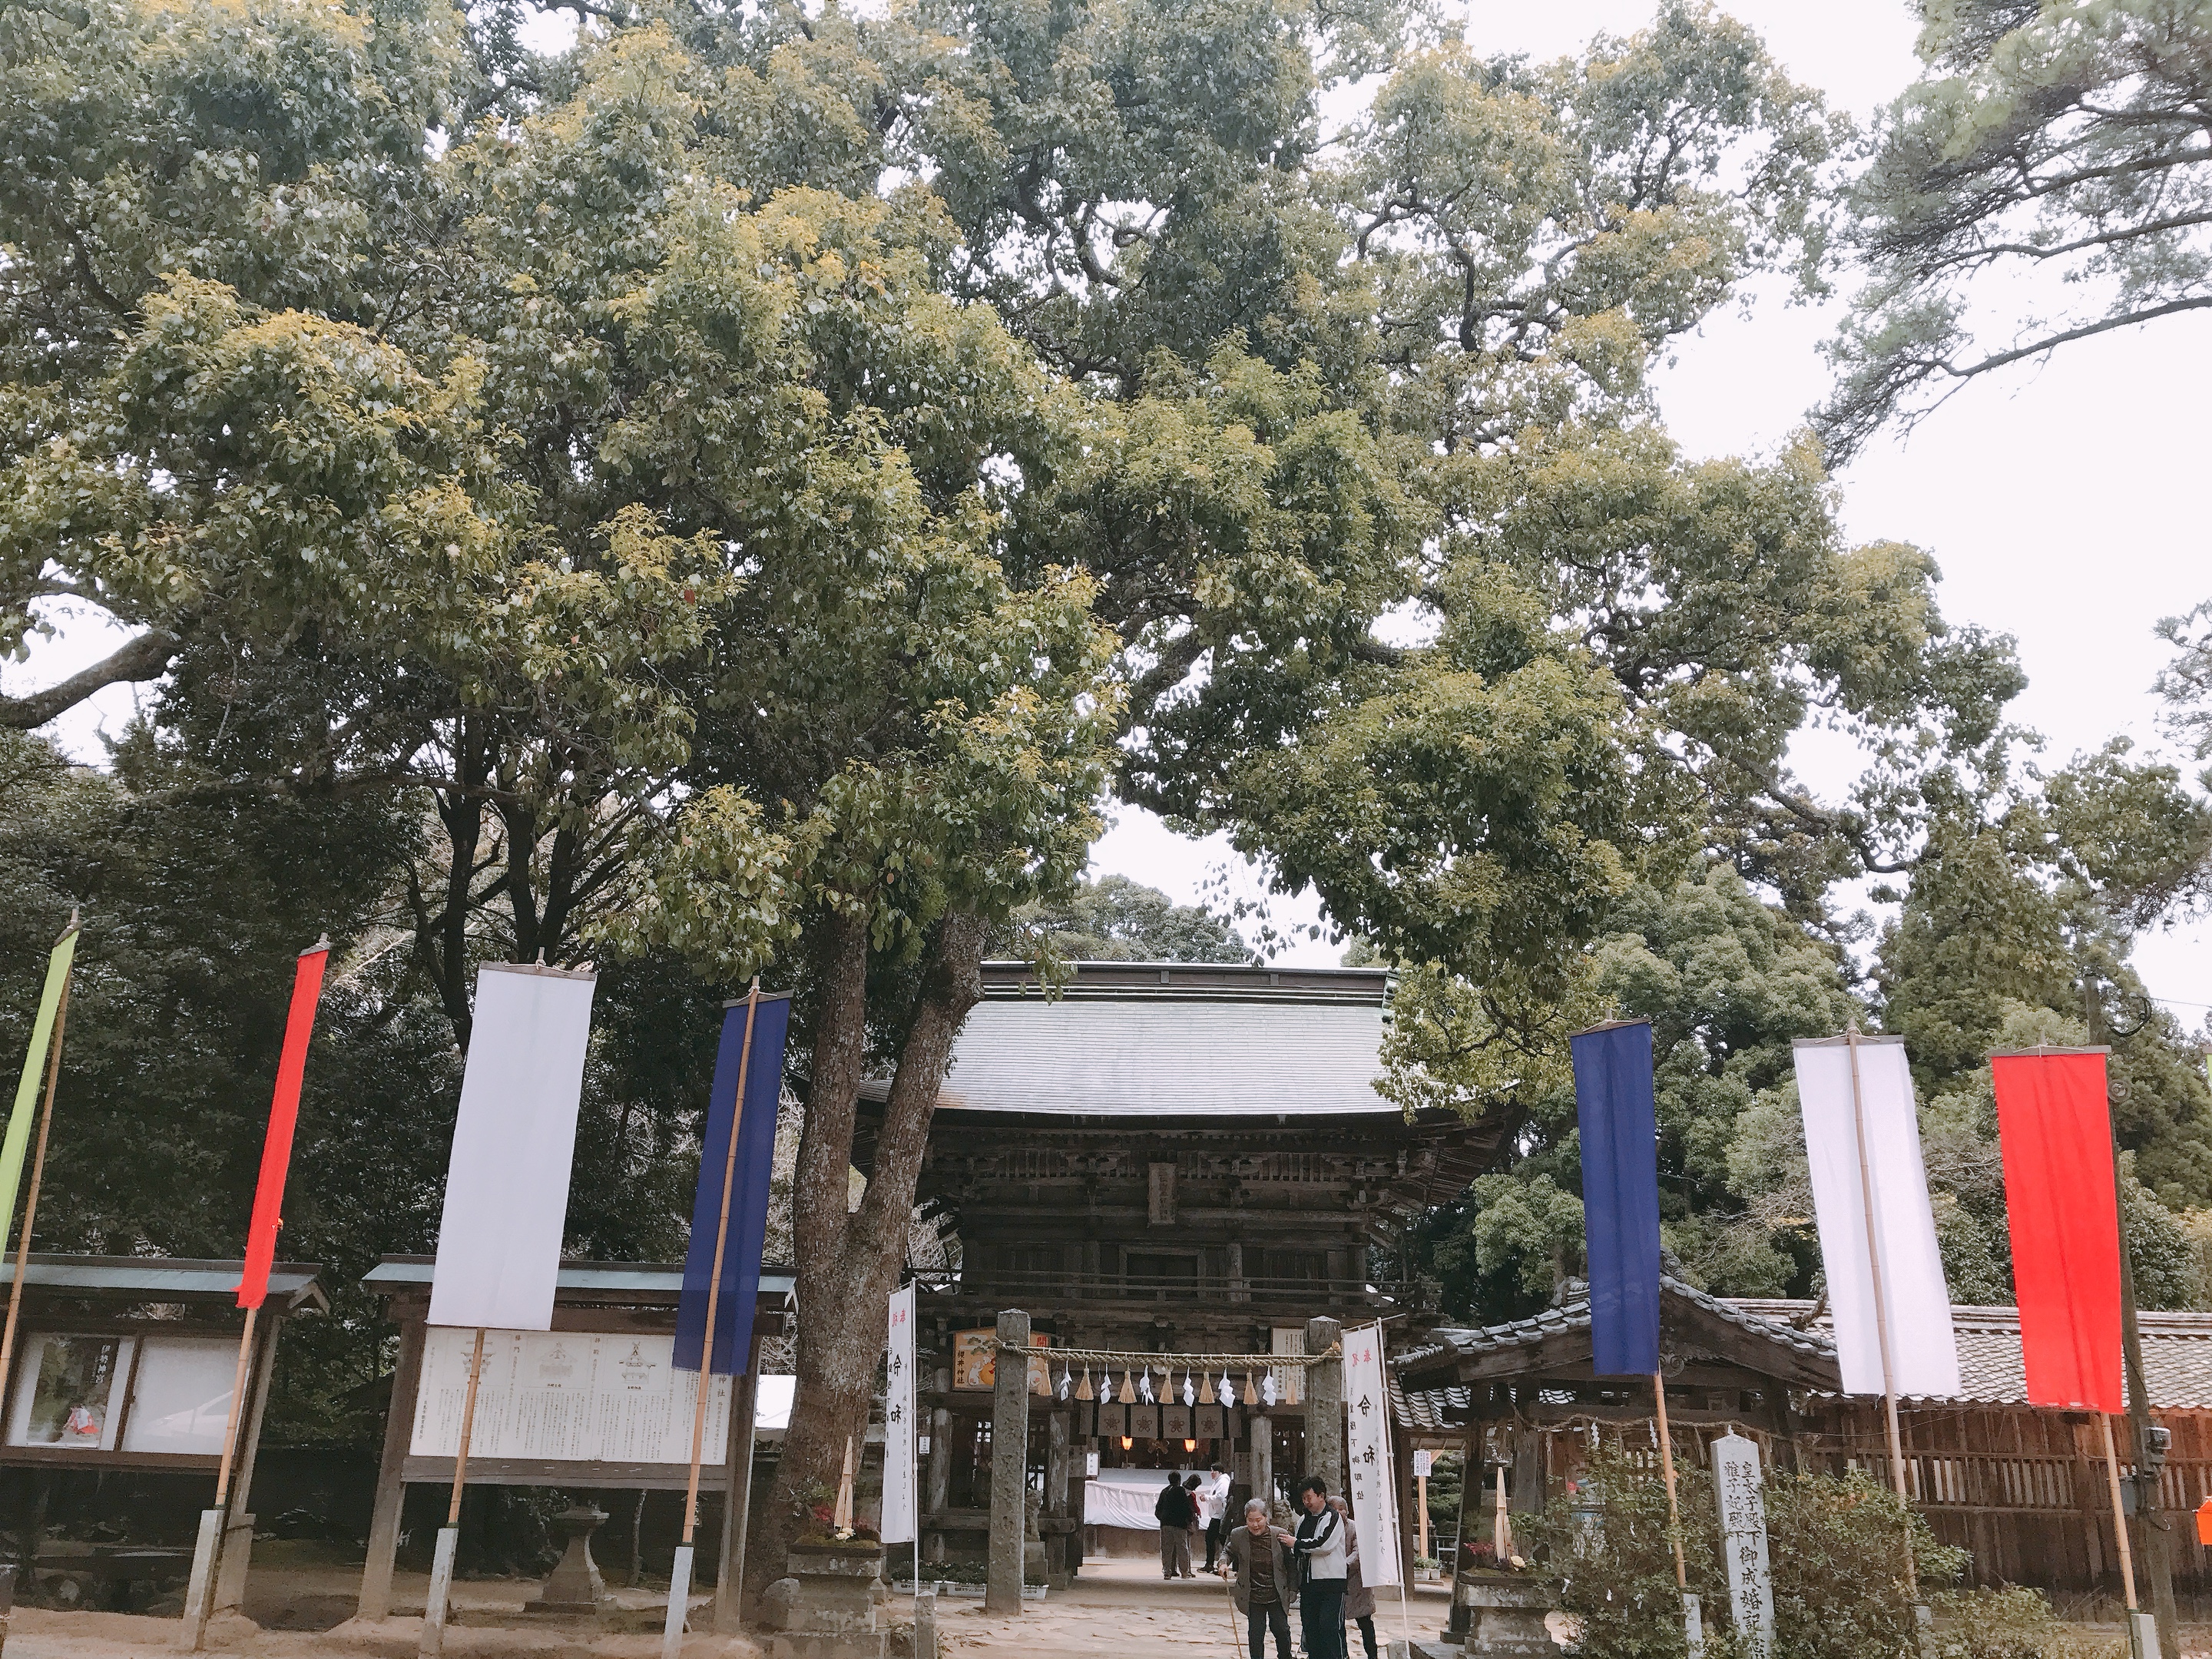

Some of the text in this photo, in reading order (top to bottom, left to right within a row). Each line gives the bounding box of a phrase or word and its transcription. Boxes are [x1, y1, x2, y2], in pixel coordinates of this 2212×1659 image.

[1724, 1461, 1745, 1545] 雅子妃殿下
[1741, 1461, 1763, 1546] 皇太子殿下
[1739, 1545, 1765, 1659] 御成婚記念
